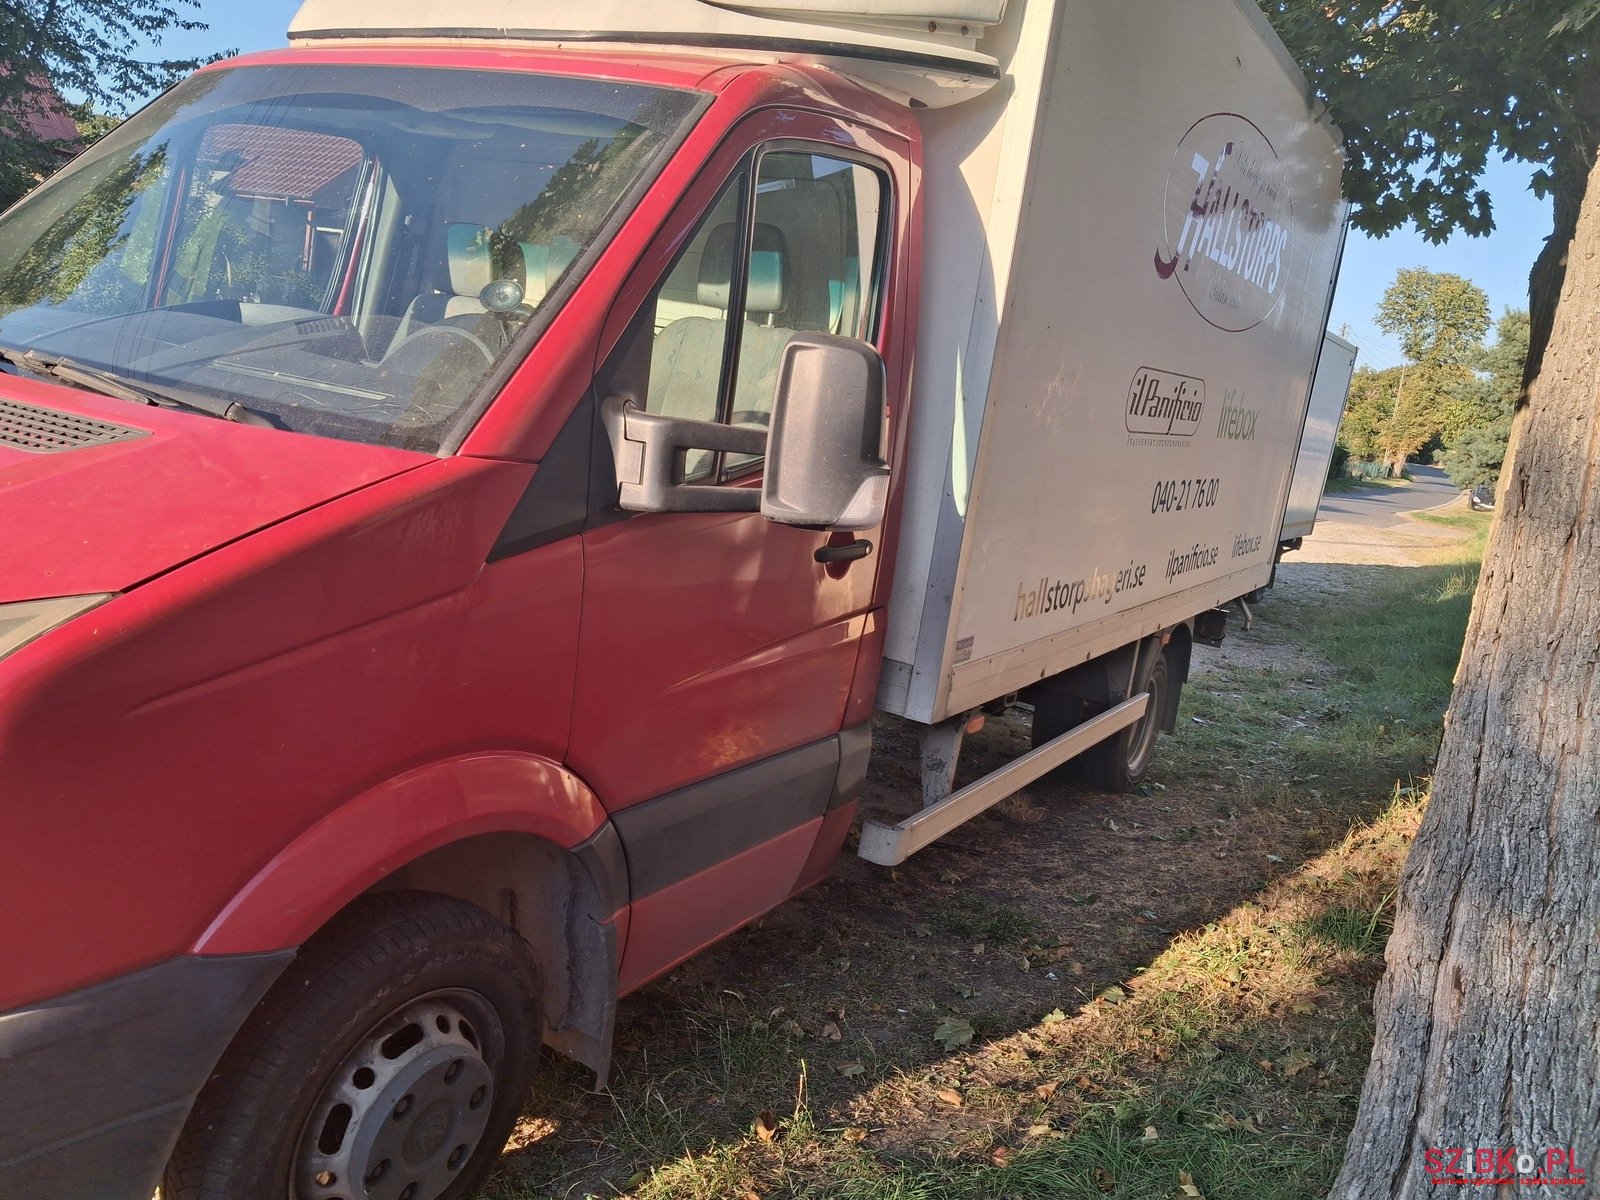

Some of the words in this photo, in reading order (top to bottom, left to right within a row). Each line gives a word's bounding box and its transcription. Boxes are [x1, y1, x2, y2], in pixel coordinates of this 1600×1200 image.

[1216, 387, 1260, 441] lifebox
[1151, 479, 1192, 515] 040-21
[1191, 478, 1207, 509] 76
[1205, 477, 1220, 508] 00
[1164, 543, 1220, 584] ilpanificio.se
[1231, 532, 1262, 560] lifebox.se
